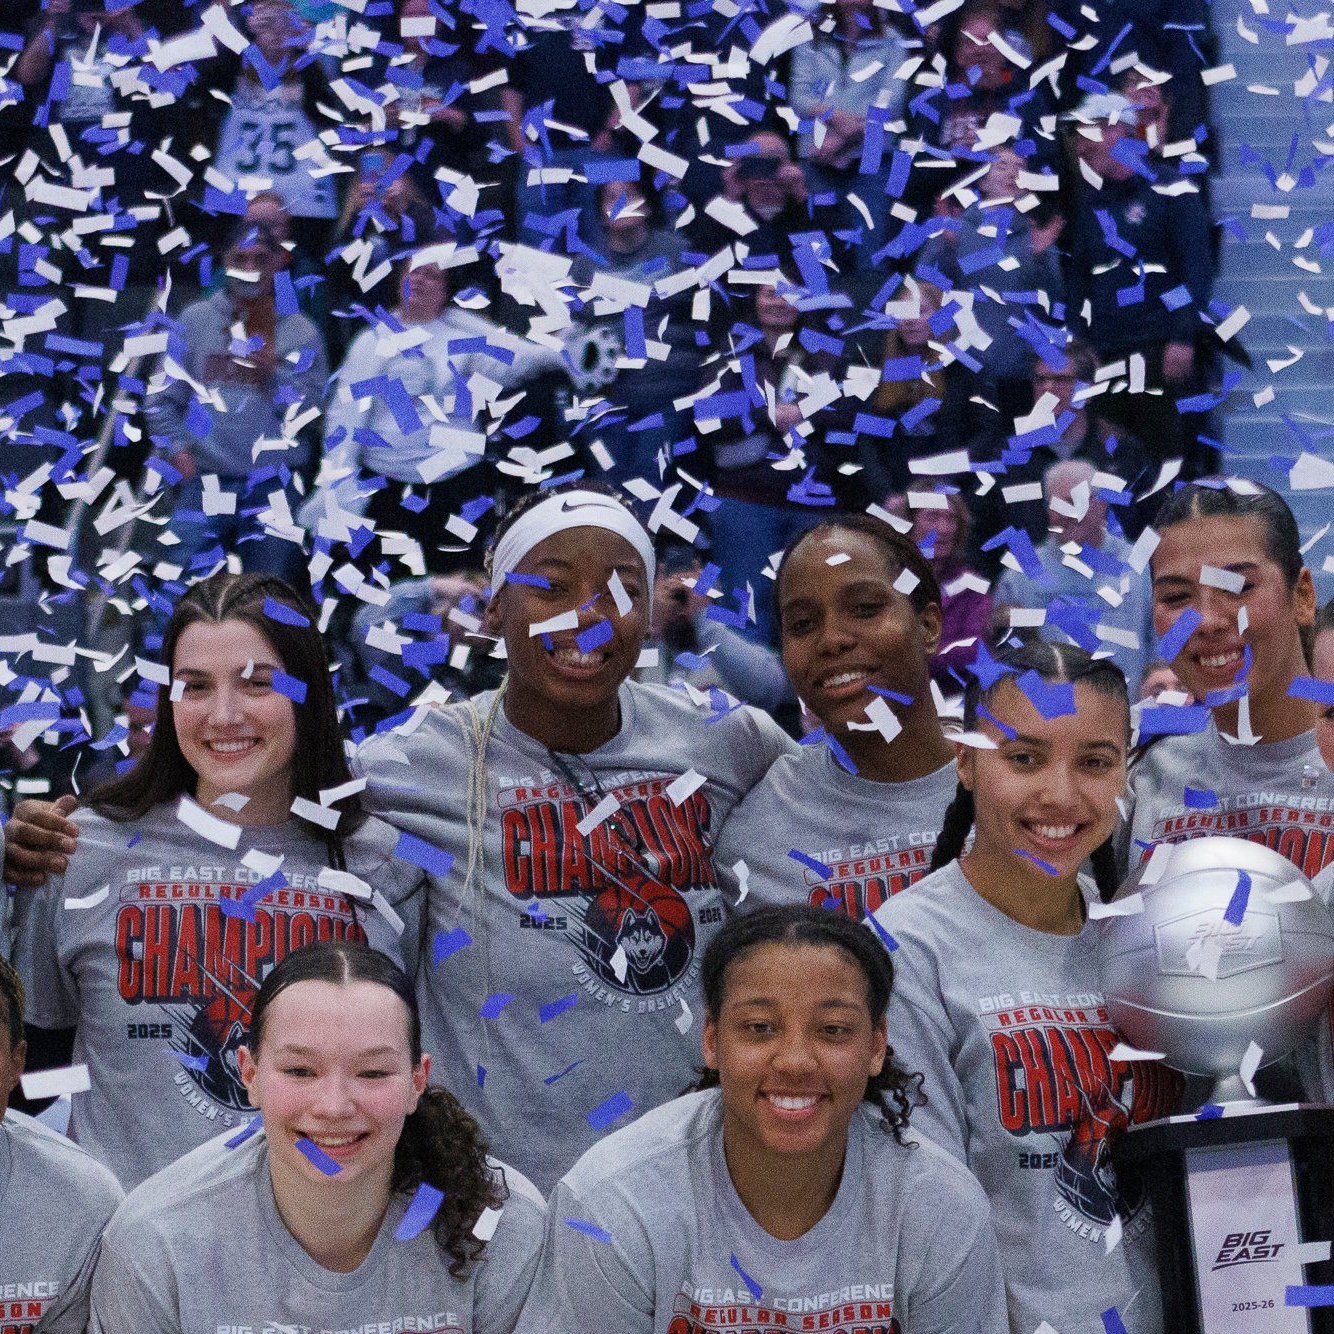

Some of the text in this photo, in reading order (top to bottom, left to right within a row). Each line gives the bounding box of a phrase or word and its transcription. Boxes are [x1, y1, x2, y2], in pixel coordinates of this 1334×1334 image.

[850, 836, 900, 859] EAST
[830, 850, 926, 877] EGULAR
[127, 868, 162, 883] BIG
[168, 866, 226, 882] EAST
[519, 911, 568, 930] 2025
[571, 961, 631, 1012] WOMEN'S
[978, 992, 1014, 1012] BIG
[998, 1007, 1088, 1026] REGULAR
[128, 1024, 172, 1039] 2025
[1222, 1230, 1272, 1248] BIG
[1215, 1243, 1285, 1263] EAST
[774, 1283, 894, 1312] CONFERENC
[1231, 1299, 1275, 1312] 2025-26
